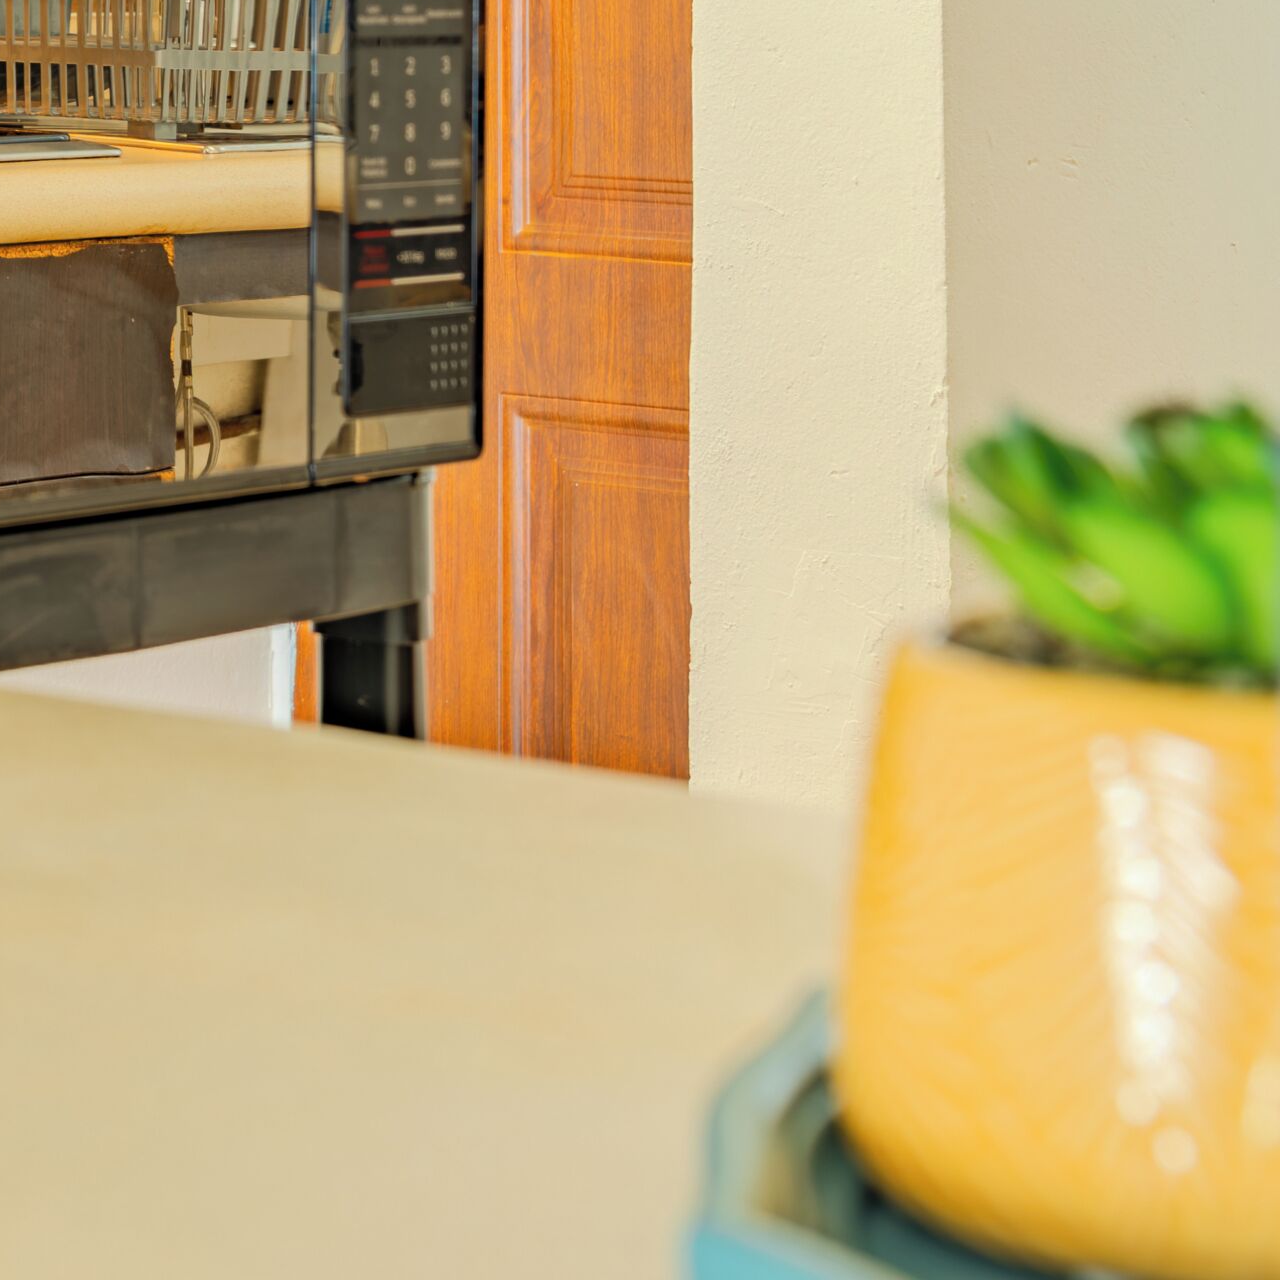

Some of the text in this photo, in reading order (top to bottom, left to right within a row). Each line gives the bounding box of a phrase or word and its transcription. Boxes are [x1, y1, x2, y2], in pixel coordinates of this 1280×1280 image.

[369, 54, 452, 78] 1 2 3
[368, 87, 452, 109] 4 5 6
[368, 120, 452, 144] 7 8 9
[404, 155, 417, 176] 0
